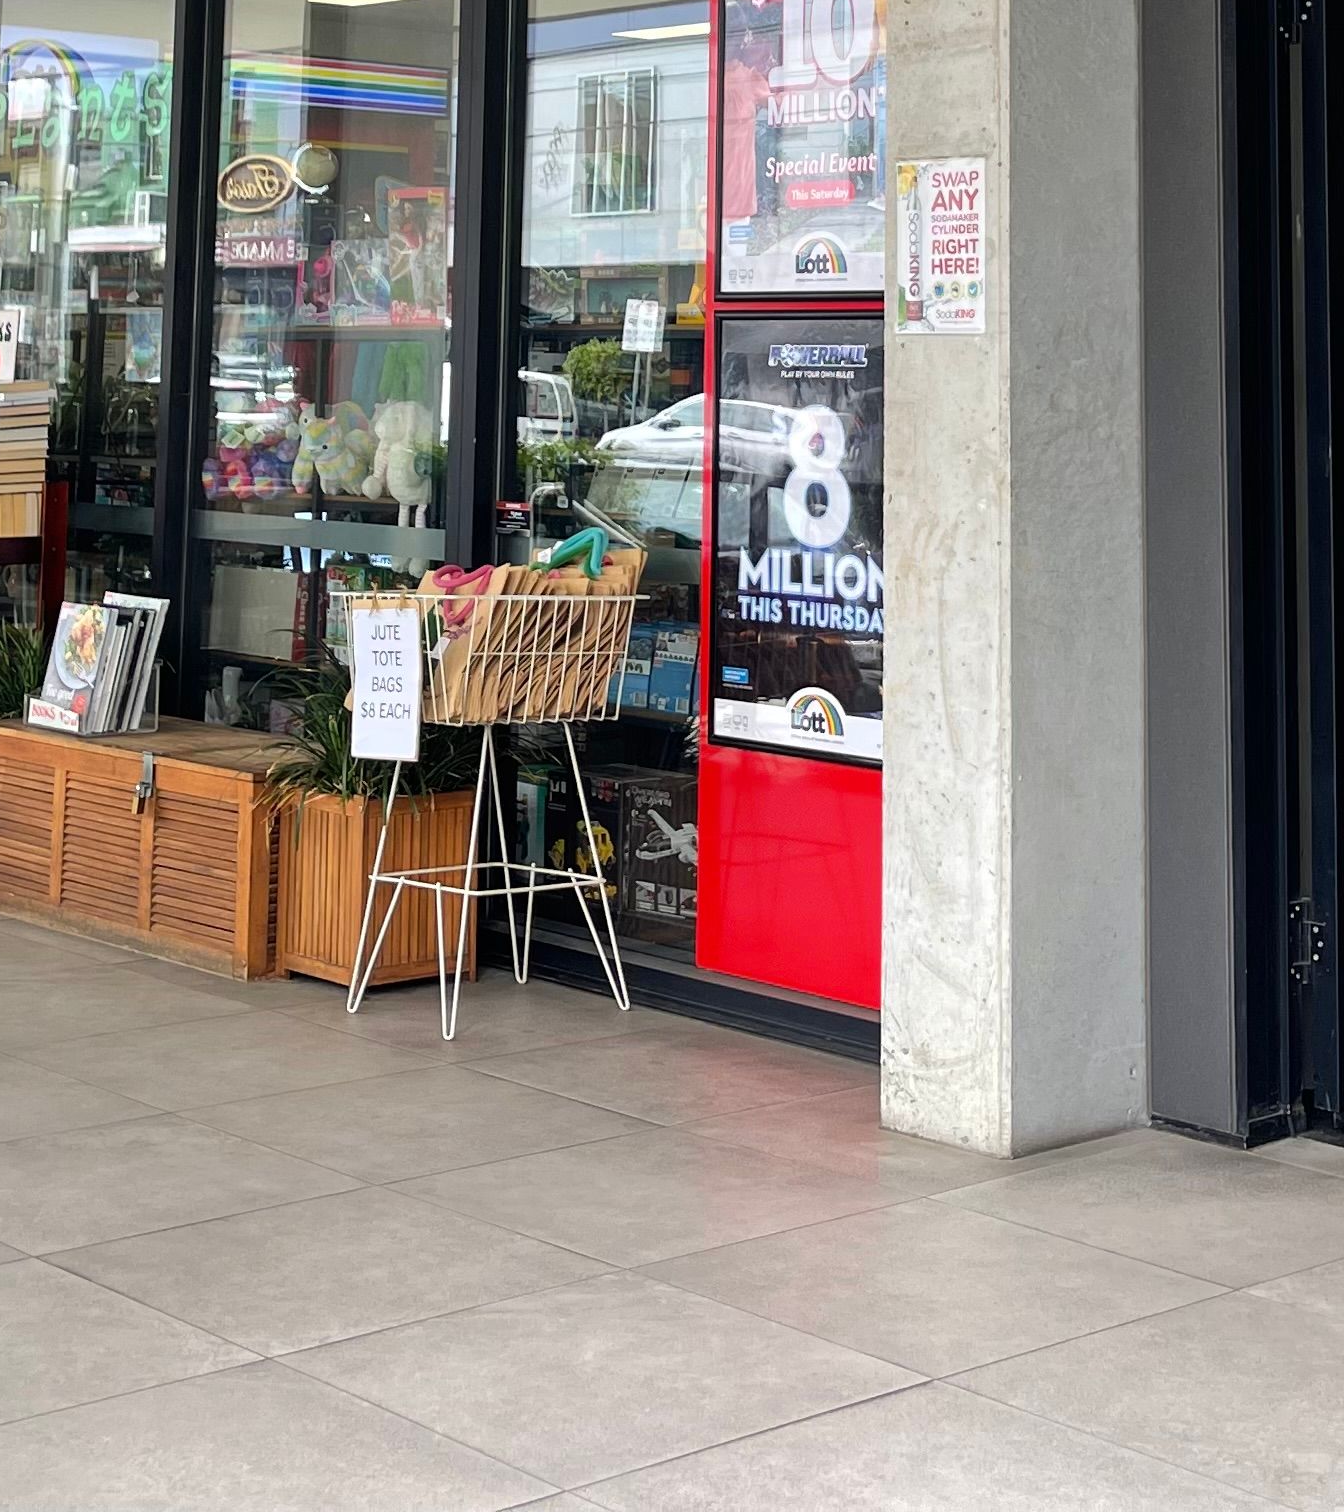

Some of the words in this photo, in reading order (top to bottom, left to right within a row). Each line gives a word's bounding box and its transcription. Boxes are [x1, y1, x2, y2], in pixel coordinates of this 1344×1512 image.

[767, 88, 877, 128] MILLION
[765, 155, 825, 183] Special
[829, 151, 877, 172] Event
[931, 170, 979, 188] SWAP
[791, 189, 809, 200] This
[810, 187, 849, 202] Saturday
[931, 189, 979, 211] ANY
[931, 223, 979, 235] CYLINDER
[931, 239, 979, 255] RIGHT
[795, 254, 830, 274] Lott
[931, 257, 979, 274] HERE!
[935, 308, 975, 320] SodaKING
[768, 343, 868, 368] POWERBALL
[804, 370, 820, 378] YOUR
[738, 545, 884, 602] MILLION
[738, 595, 782, 623] THIS
[371, 624, 401, 640] JUTE
[371, 650, 402, 667] TOTE
[371, 676, 403, 693] BAGS
[360, 702, 376, 719] $8
[379, 703, 411, 720] EACH
[790, 709, 826, 734] Lott
